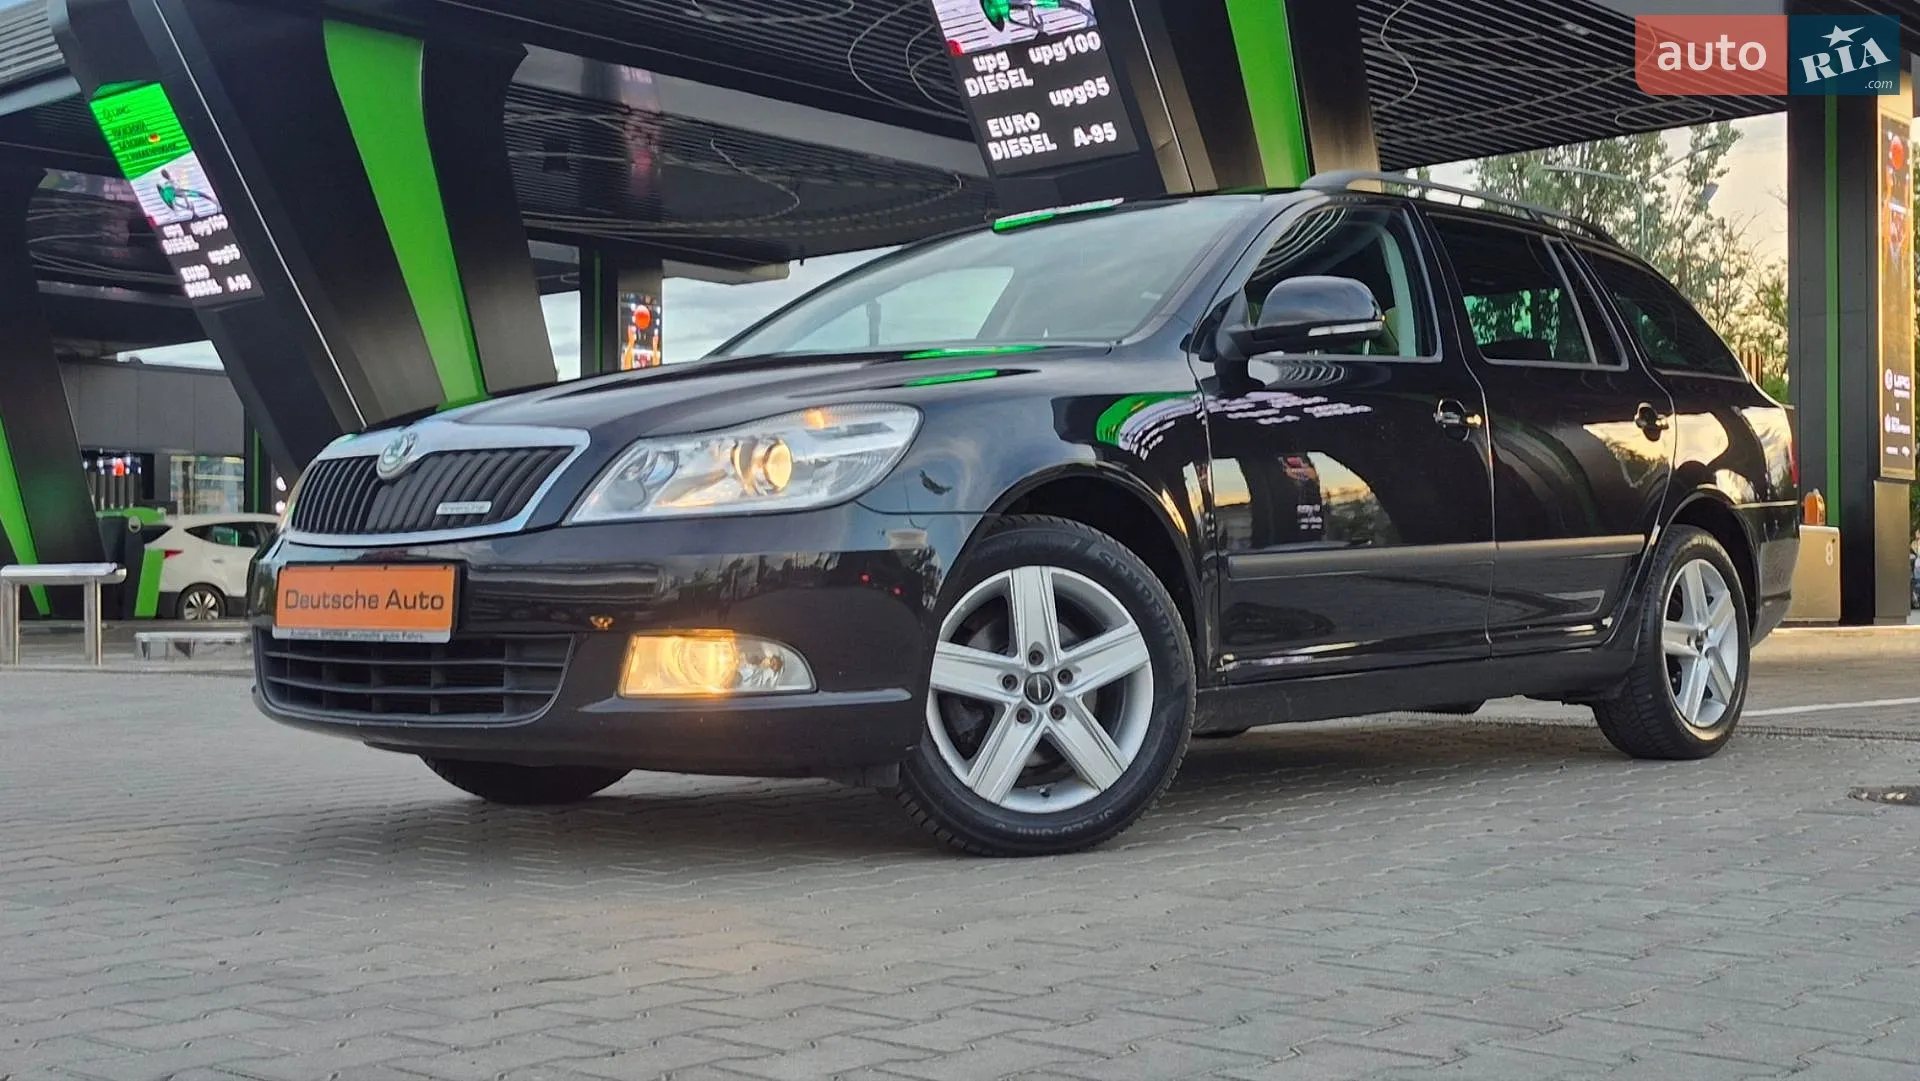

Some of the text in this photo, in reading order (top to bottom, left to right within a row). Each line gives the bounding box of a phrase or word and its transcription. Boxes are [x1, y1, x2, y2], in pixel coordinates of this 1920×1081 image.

[972, 31, 1102, 73] upg upg100
[964, 67, 1034, 98] DIESEL
[1048, 76, 1111, 108] upg95
[986, 112, 1041, 138] EURO
[987, 121, 1117, 161] DIESEL A-95
[1826, 542, 1834, 567] 8
[284, 589, 445, 610] Deutsche Auto
